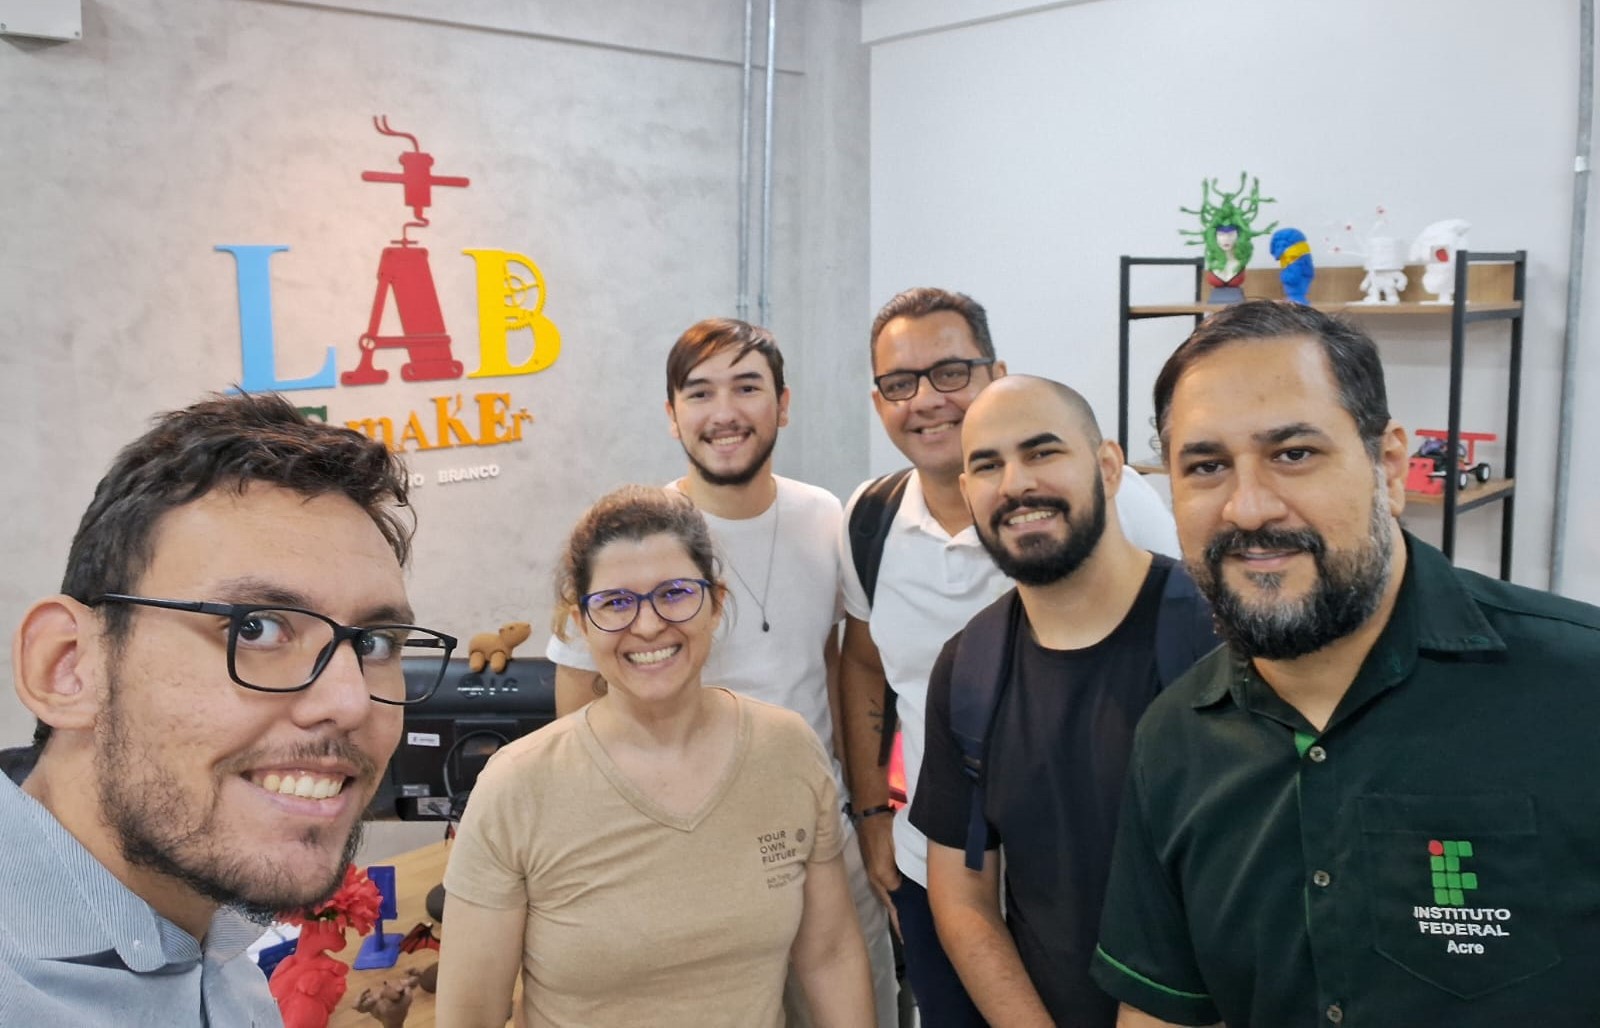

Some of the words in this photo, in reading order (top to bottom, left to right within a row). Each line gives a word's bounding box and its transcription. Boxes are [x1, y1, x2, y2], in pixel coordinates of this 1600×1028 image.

[214, 243, 561, 394] LAB
[438, 464, 499, 484] BRANCO
[757, 830, 786, 844] YOUR
[760, 841, 786, 854] OWN
[762, 848, 796, 864] FUTURE
[1413, 906, 1511, 921] INSTITUTO
[1418, 921, 1510, 936] FEDERAL
[1447, 940, 1485, 954] Acre
